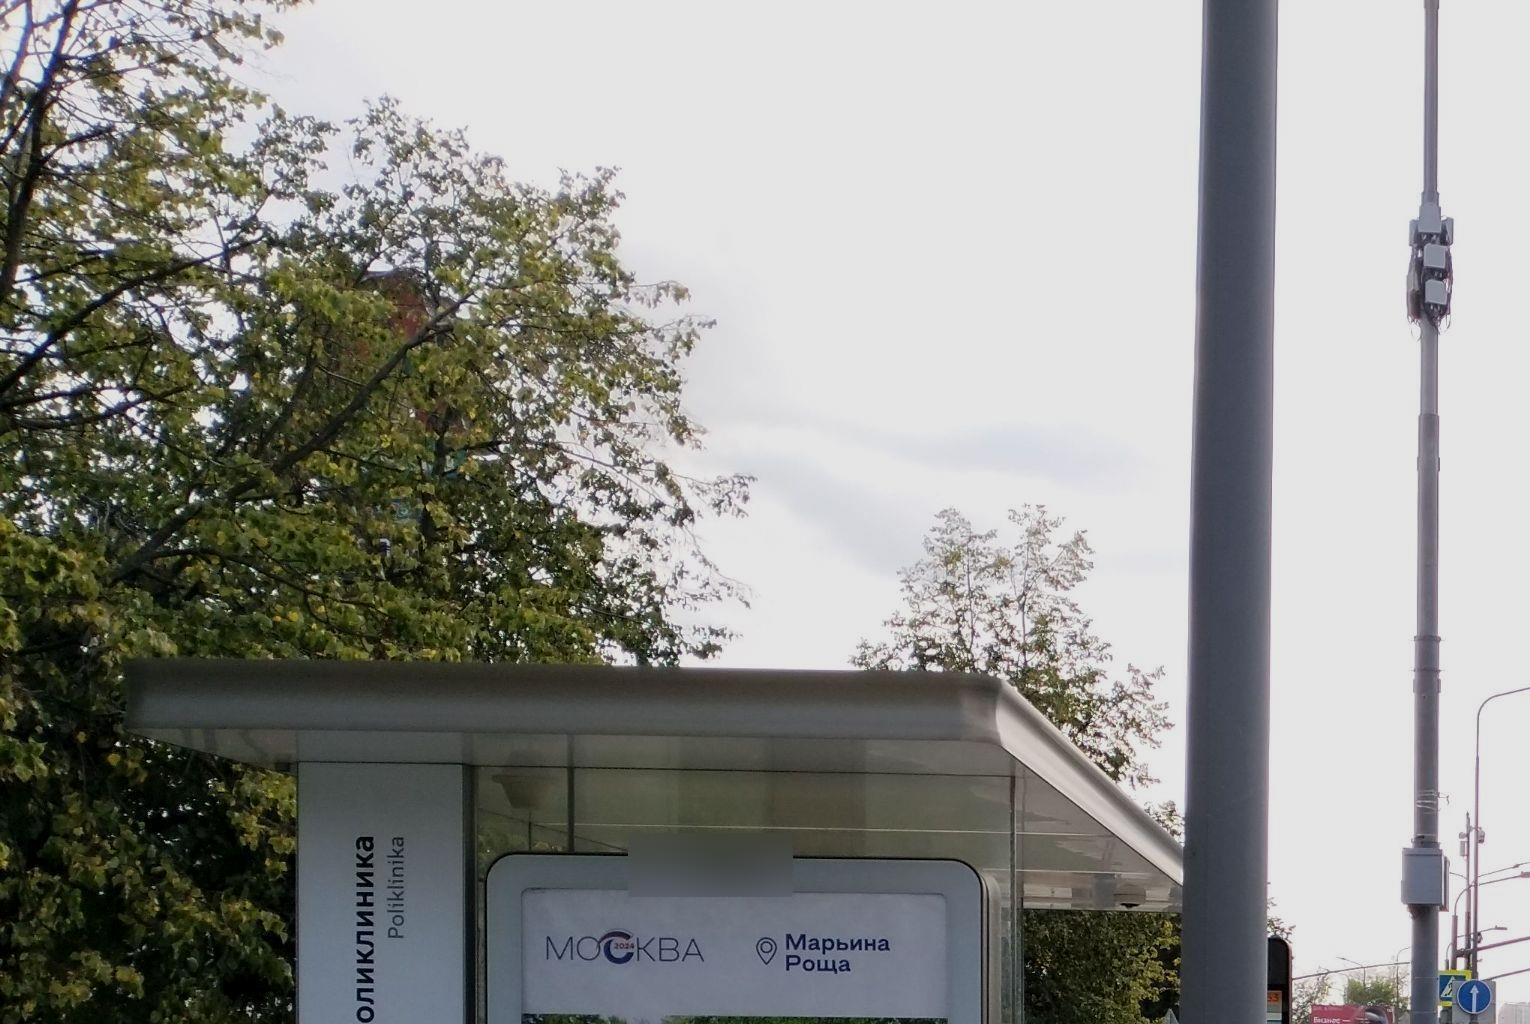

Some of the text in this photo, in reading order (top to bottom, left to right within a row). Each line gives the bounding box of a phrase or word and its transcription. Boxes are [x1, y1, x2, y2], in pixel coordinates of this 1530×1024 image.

[387, 836, 404, 938] Poliklinika
[545, 929, 704, 965] МОСКВА
[786, 933, 890, 956] Марьина
[786, 955, 851, 973] Роща
